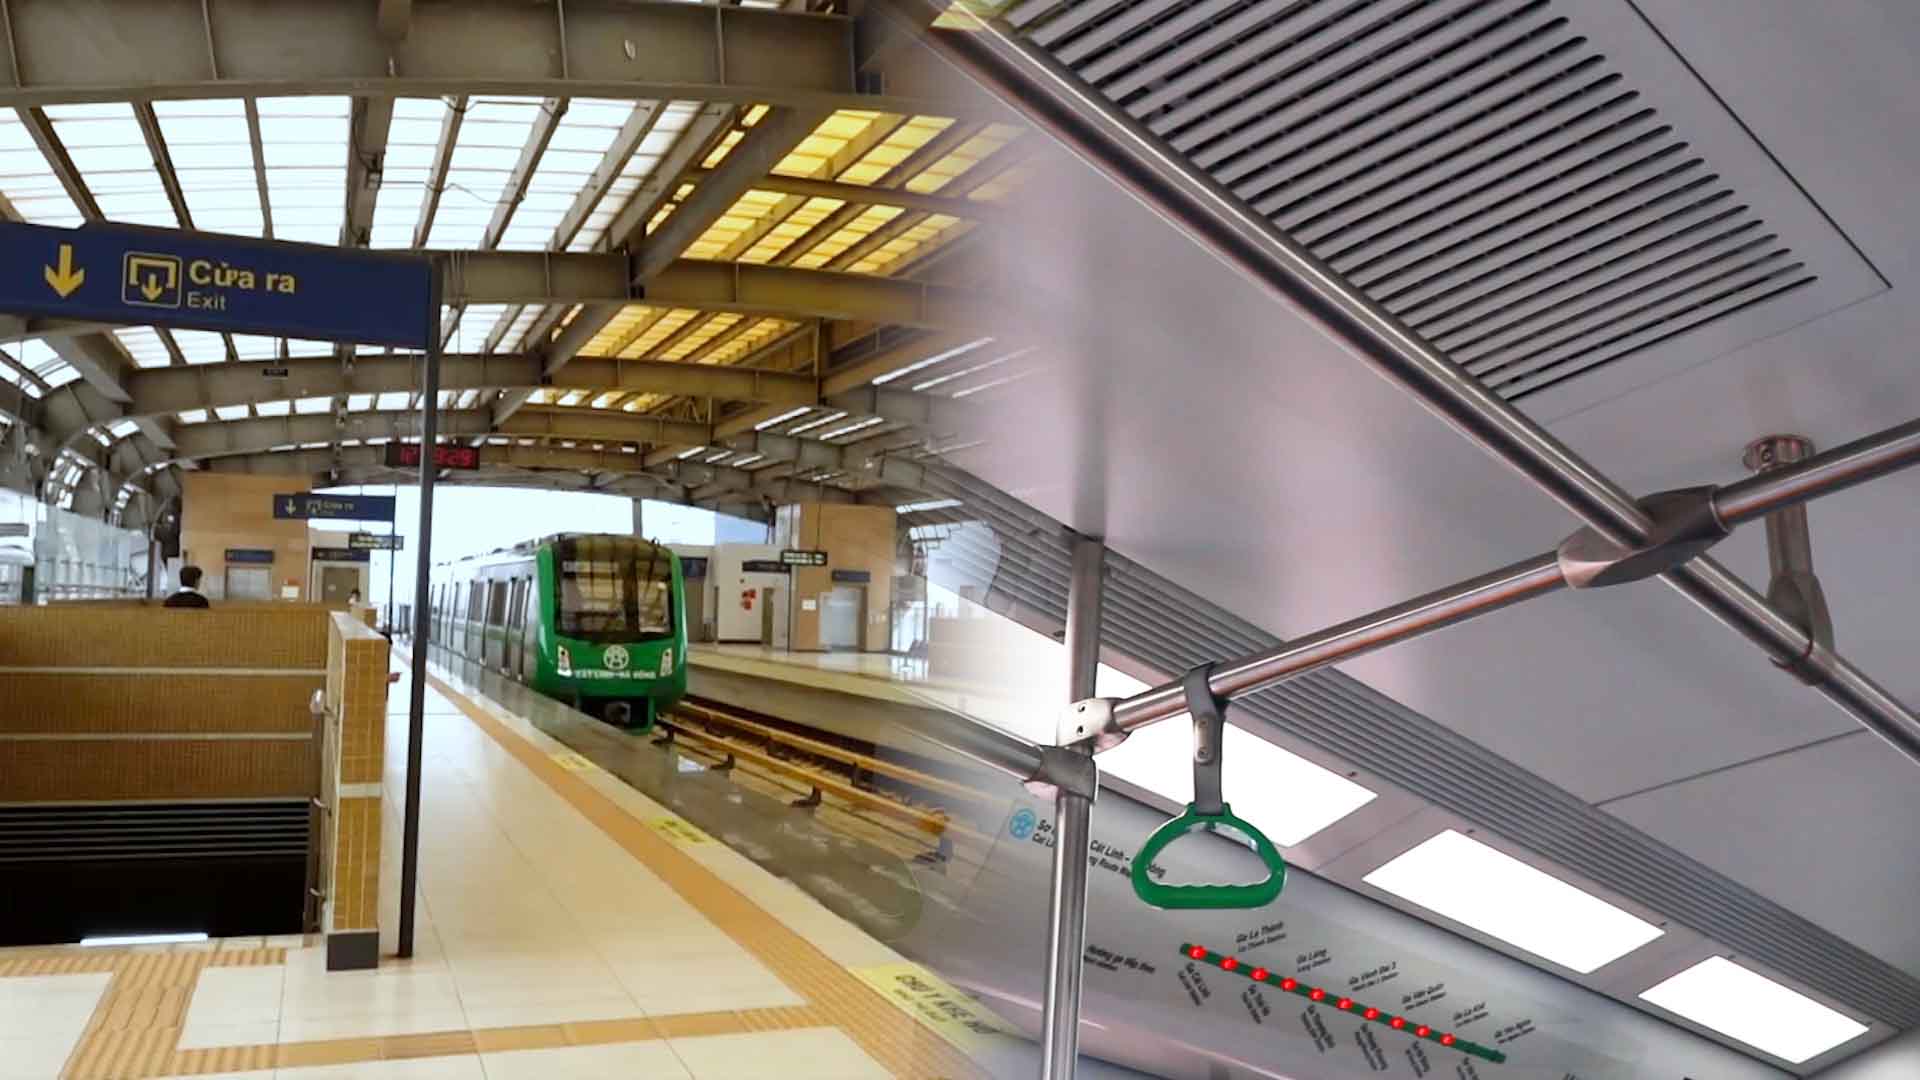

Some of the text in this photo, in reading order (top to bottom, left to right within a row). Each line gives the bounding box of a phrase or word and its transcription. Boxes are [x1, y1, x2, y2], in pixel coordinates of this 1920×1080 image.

[189, 260, 296, 294] Cửa ra
[187, 291, 227, 311] Exit
